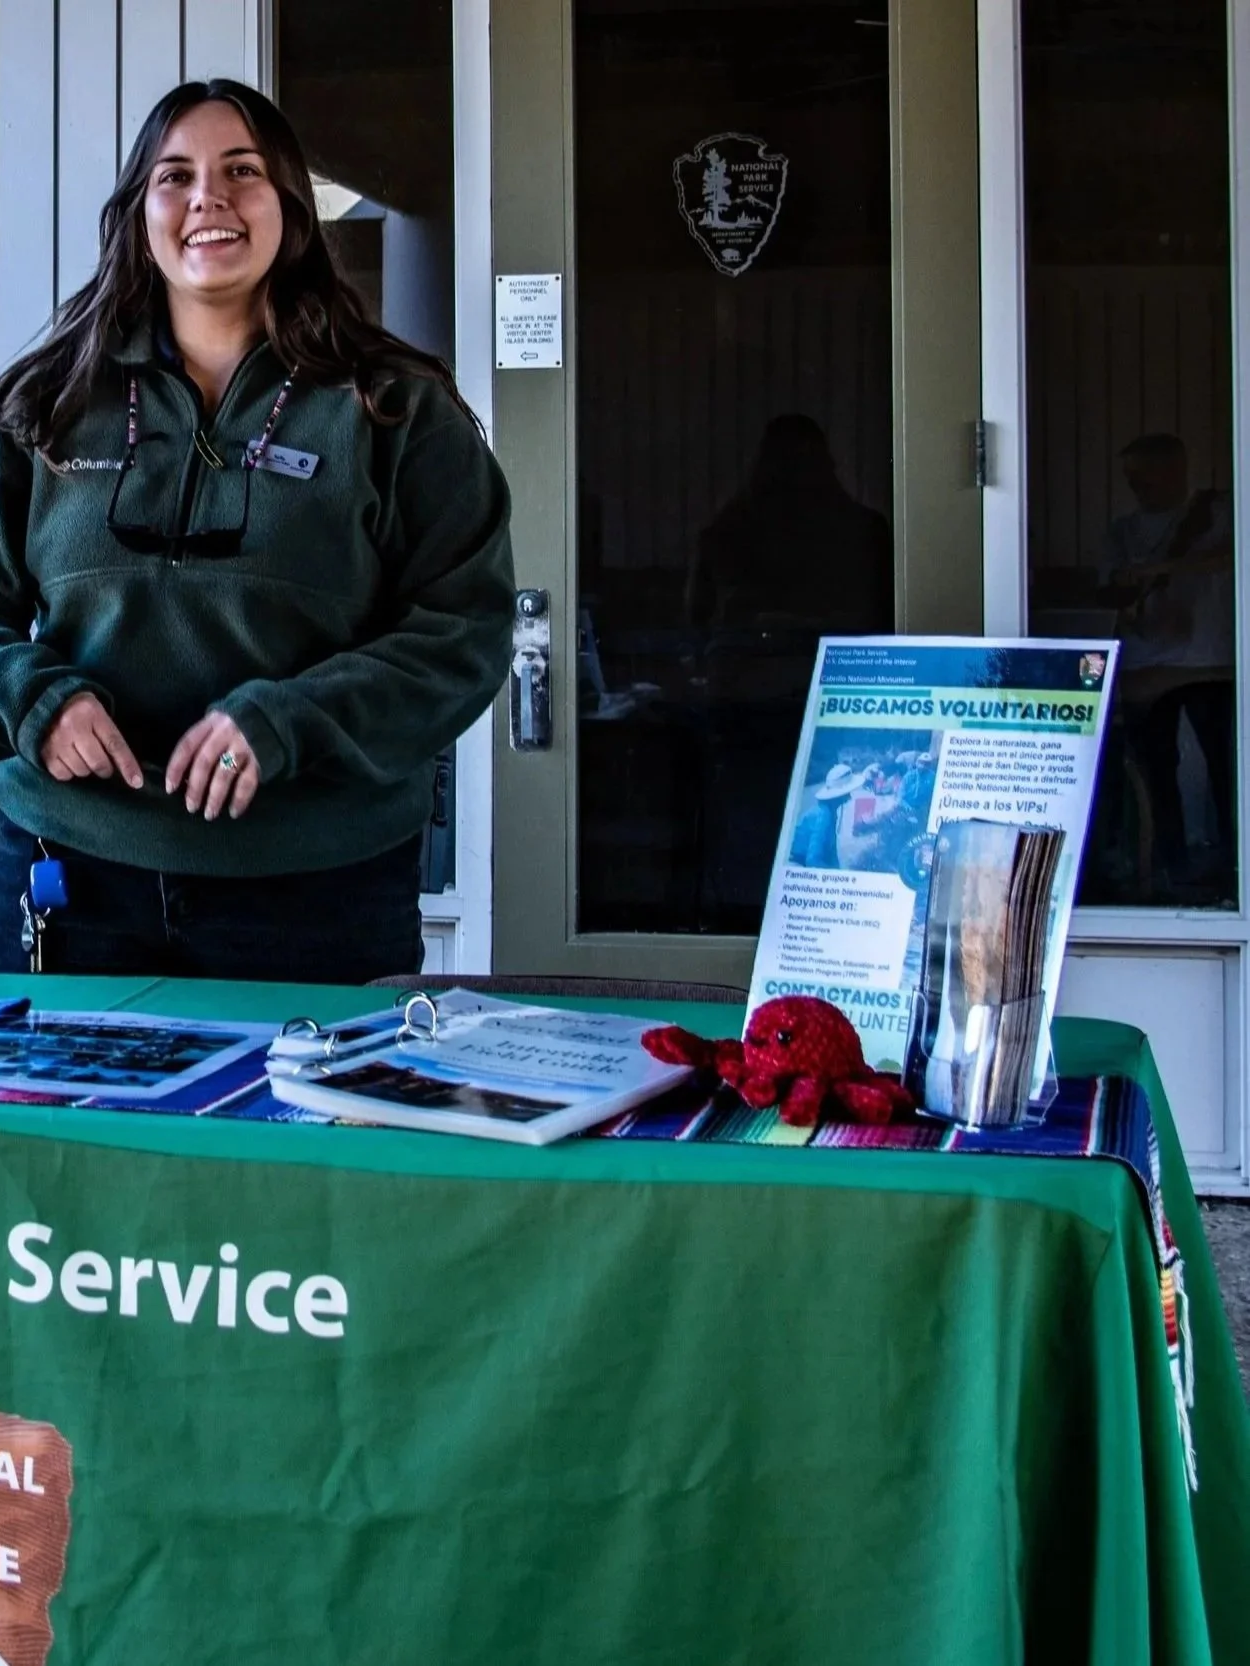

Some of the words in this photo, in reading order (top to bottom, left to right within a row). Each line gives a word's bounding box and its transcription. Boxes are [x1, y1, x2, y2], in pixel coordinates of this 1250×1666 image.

[731, 163, 779, 172] NATIONAL
[738, 184, 774, 194] SERVICE
[72, 458, 124, 470] Columbia
[820, 698, 934, 716] ¡BUSCAMOS
[940, 700, 1094, 721] VOLUNTARIOS!
[950, 736, 981, 746] Explora
[982, 737, 990, 745] la
[992, 738, 1038, 748] naturaleza,
[1040, 742, 1062, 750] gana
[948, 749, 994, 758] experiencia
[1020, 752, 1042, 760] único
[1045, 754, 1075, 763] parque
[946, 760, 980, 768] nacional
[982, 761, 992, 769] de
[995, 762, 1011, 770] San
[1014, 762, 1038, 772] Diego
[1048, 765, 1074, 774] ayuda
[944, 770, 972, 779] futuras
[974, 773, 1030, 783] generaciones
[1041, 775, 1078, 784] disfrutar
[942, 781, 974, 790] Cabrillo
[976, 784, 1010, 792] National
[1012, 785, 1064, 796] Monument...
[939, 795, 980, 810] ¡Únase
[994, 800, 1011, 812] los
[1016, 800, 1048, 814] VIPs!
[786, 870, 819, 881] Familias,
[822, 874, 849, 883] grupos
[783, 884, 822, 894] individuos
[842, 888, 894, 899] bienvenidos!
[780, 894, 836, 910] Apoyanos
[840, 902, 858, 911] en:
[765, 980, 900, 1009] CONTACTANOS
[6, 1220, 349, 1337] Service
